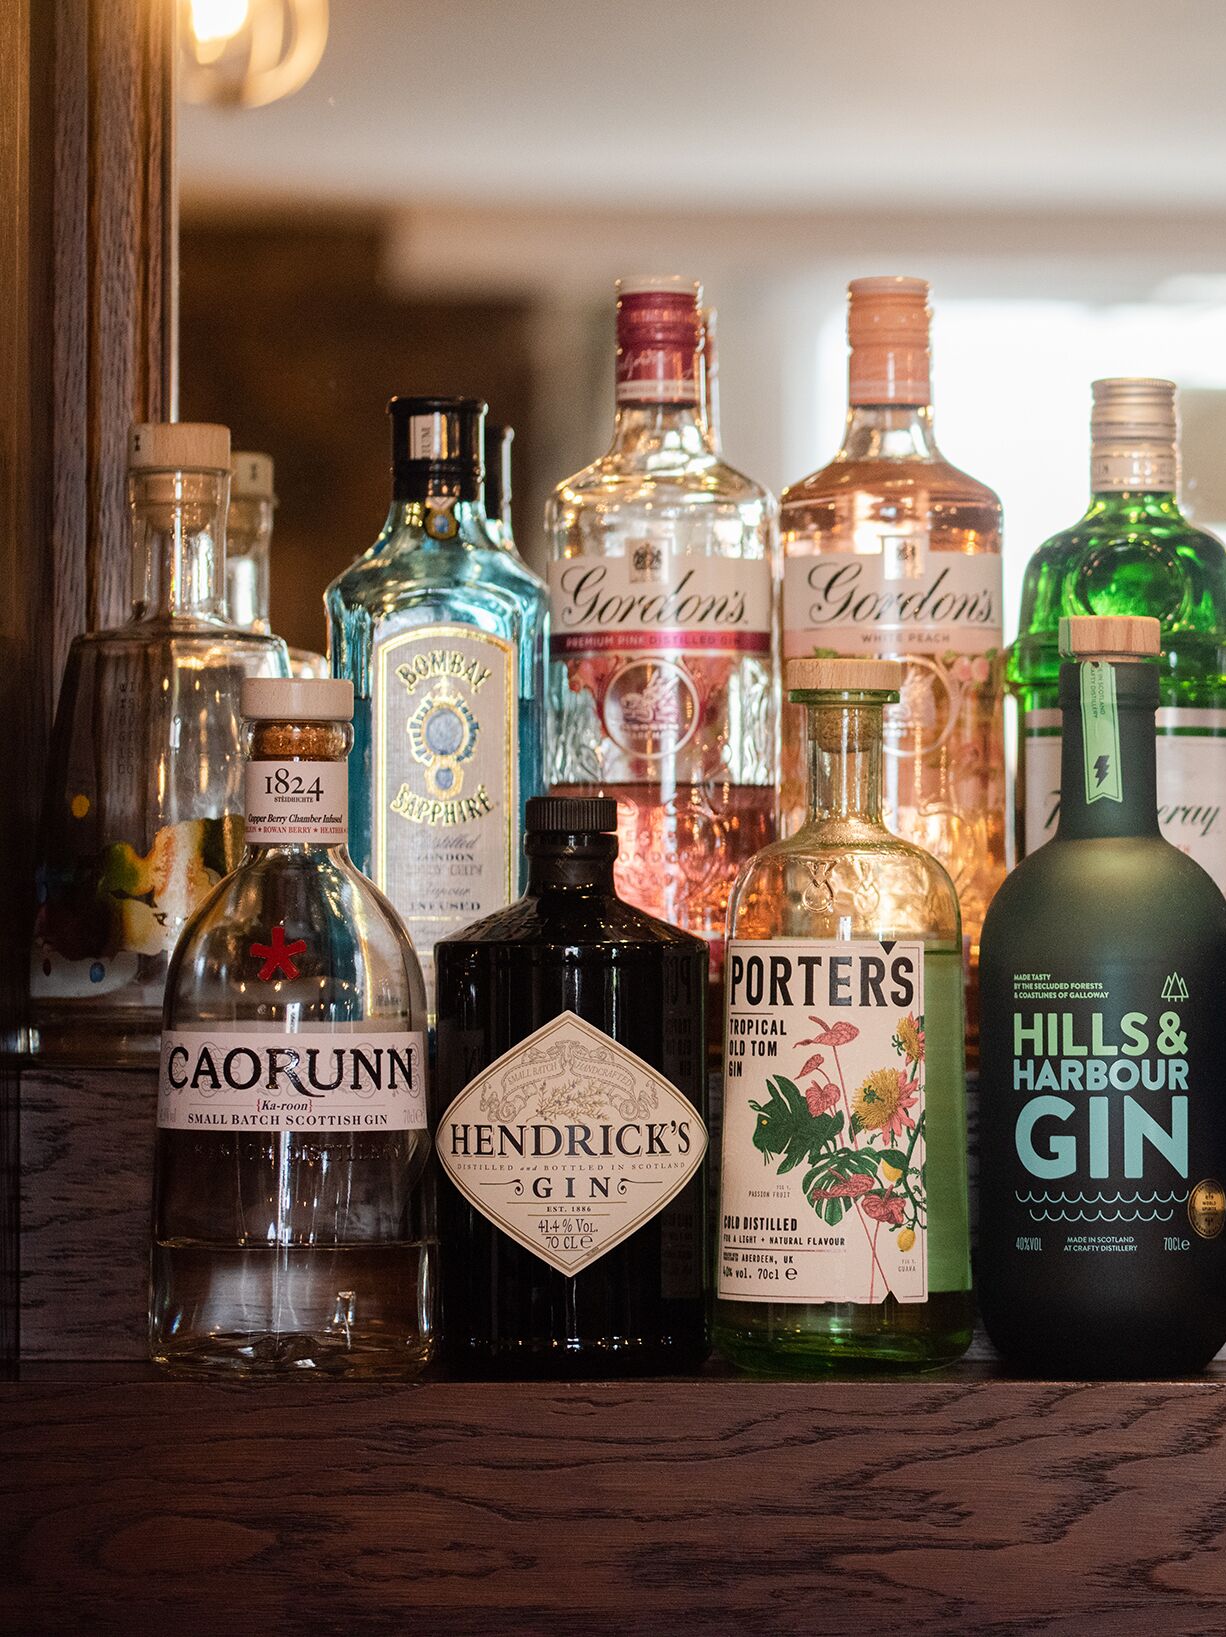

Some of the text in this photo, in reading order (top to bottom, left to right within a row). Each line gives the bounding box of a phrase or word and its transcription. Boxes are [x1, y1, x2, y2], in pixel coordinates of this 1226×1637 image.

[560, 565, 746, 627] Gordon's
[807, 562, 993, 624] Gordon's
[566, 635, 614, 647] PREMIUM
[618, 635, 645, 645] PINK
[649, 635, 715, 646] DISTILLED
[908, 633, 950, 642] PEACH
[395, 649, 492, 695] BOMBAY
[265, 768, 324, 802] 1824
[390, 783, 494, 827] SAPPHIRE
[267, 813, 287, 825] Berry
[288, 814, 321, 823] Chamber
[263, 825, 287, 834] ROWAN
[288, 826, 311, 834] BERRY
[730, 1018, 787, 1036] TROPICAL
[729, 1040, 777, 1057] OLD TOM
[168, 1047, 413, 1097] CAORUNN
[507, 1063, 558, 1086] SMALL BATCH
[575, 1062, 633, 1087] HANDCRAFTED
[729, 1061, 742, 1077] GIN
[1013, 1059, 1189, 1091] HARBOUR
[188, 1113, 228, 1125] SMALL
[231, 1114, 280, 1125] BATCH
[286, 1114, 361, 1125] SCOTTISH
[365, 1114, 388, 1125] GIN
[451, 1121, 690, 1157] HENDRICK'S
[1015, 1095, 1188, 1179] GIN
[520, 1163, 537, 1171] and
[631, 1162, 685, 1170] SCOTLAND
[532, 1176, 611, 1198] GIN
[748, 1190, 770, 1198] PASSION
[562, 1218, 573, 1233] %
[723, 1214, 798, 1231] COLD DISTILLED
[546, 1236, 559, 1249] 70
[739, 1235, 757, 1243] LIGHT
[769, 1236, 803, 1246] NATURAL
[807, 1237, 845, 1246] FLAVOUR
[741, 1254, 778, 1265] ABERDEEN,
[783, 1256, 794, 1264] UK
[736, 1268, 752, 1279] vol.
[758, 1268, 780, 1280] 70cl
